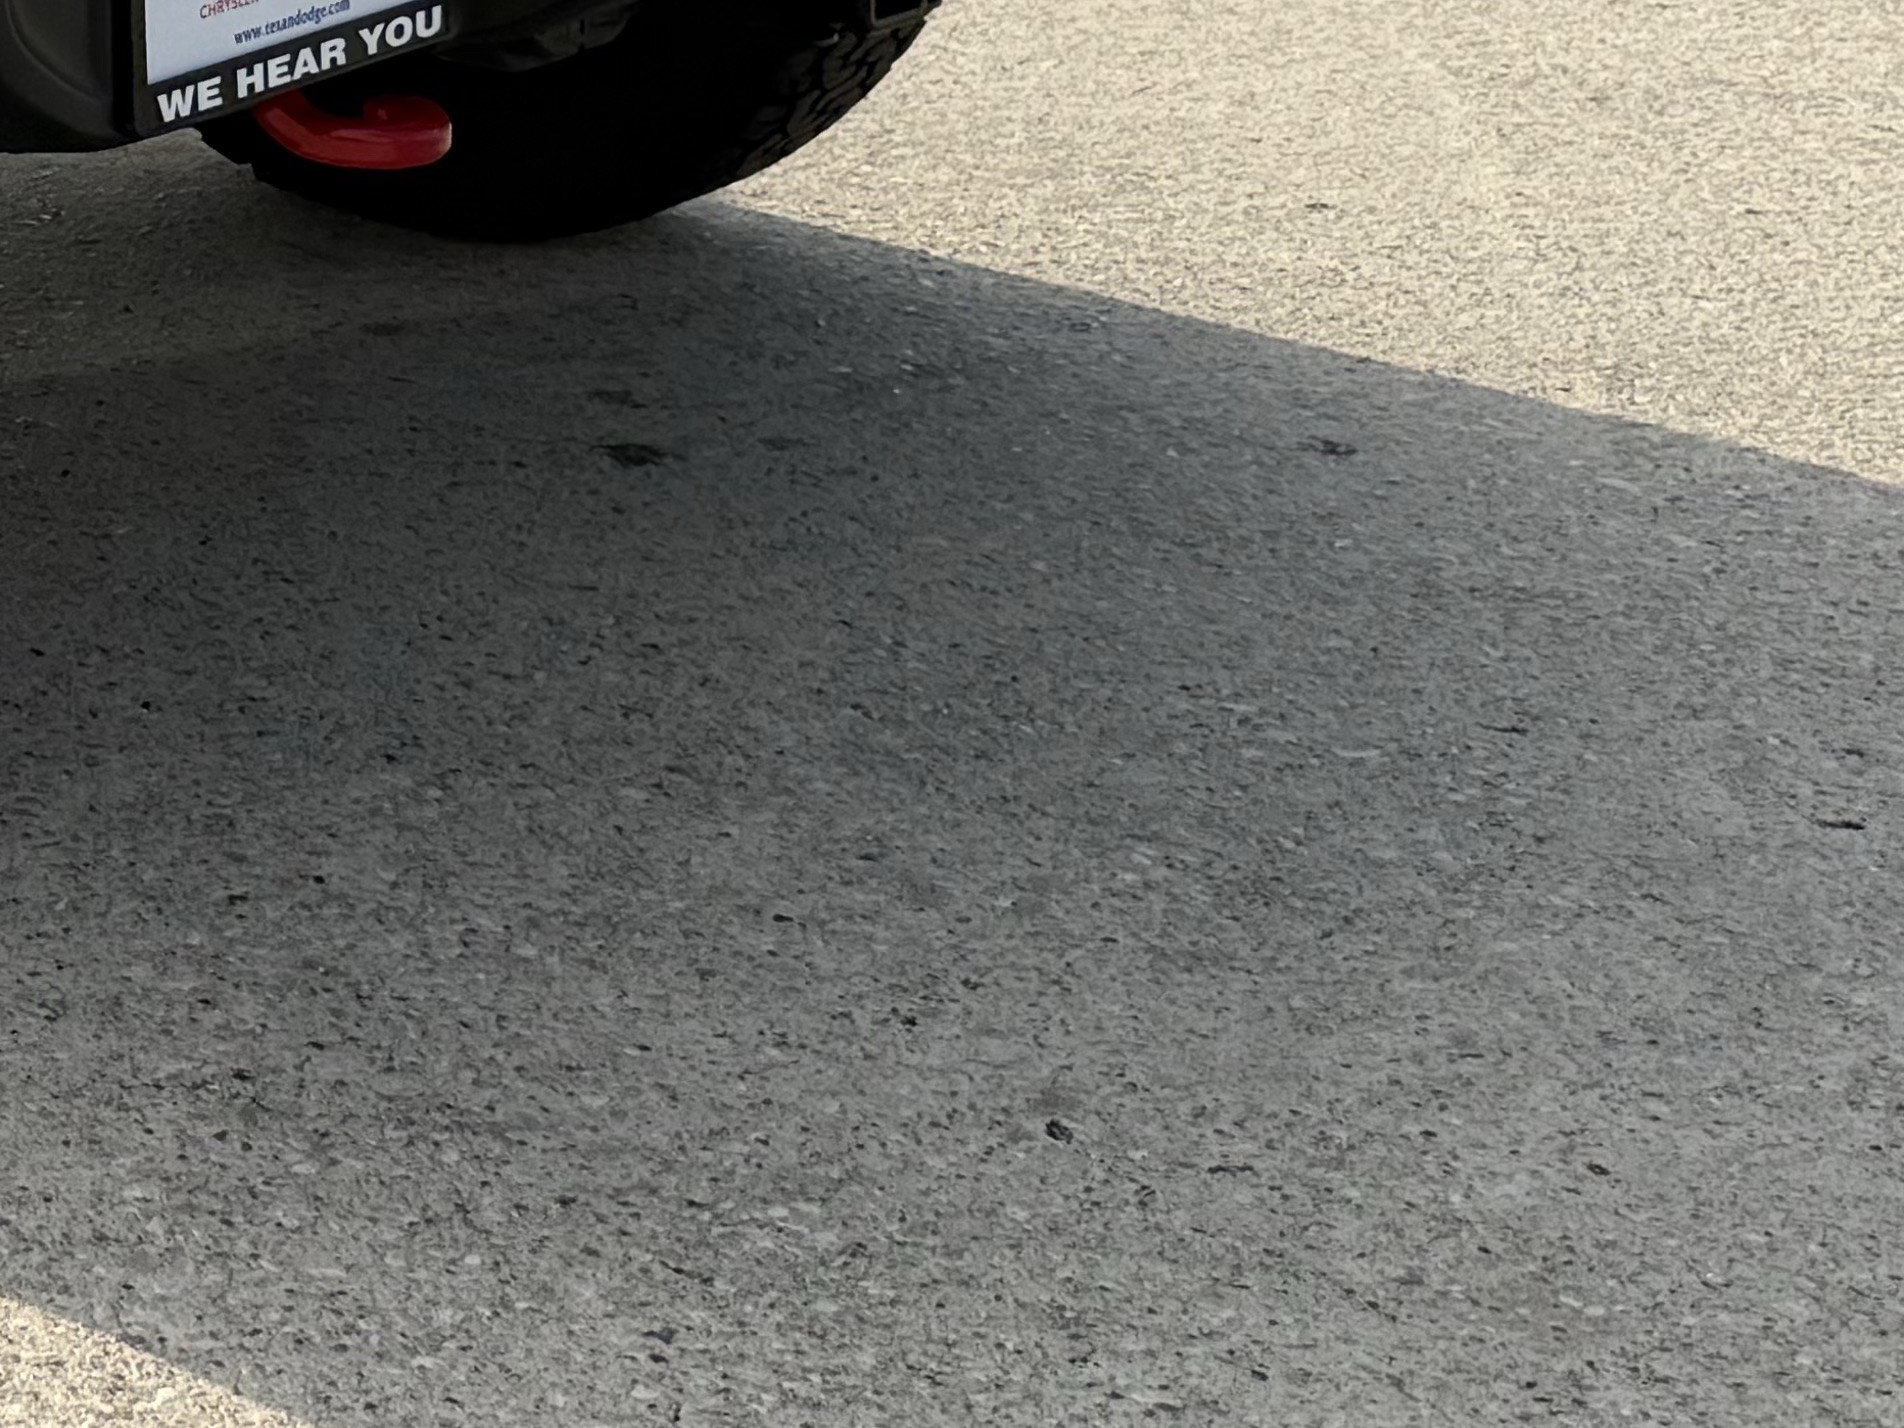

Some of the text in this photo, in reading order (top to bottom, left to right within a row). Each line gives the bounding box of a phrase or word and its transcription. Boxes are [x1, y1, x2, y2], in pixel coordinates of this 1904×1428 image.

[233, 0, 351, 43] www.texandodge.com
[157, 5, 442, 123] WE HEAR YOU
